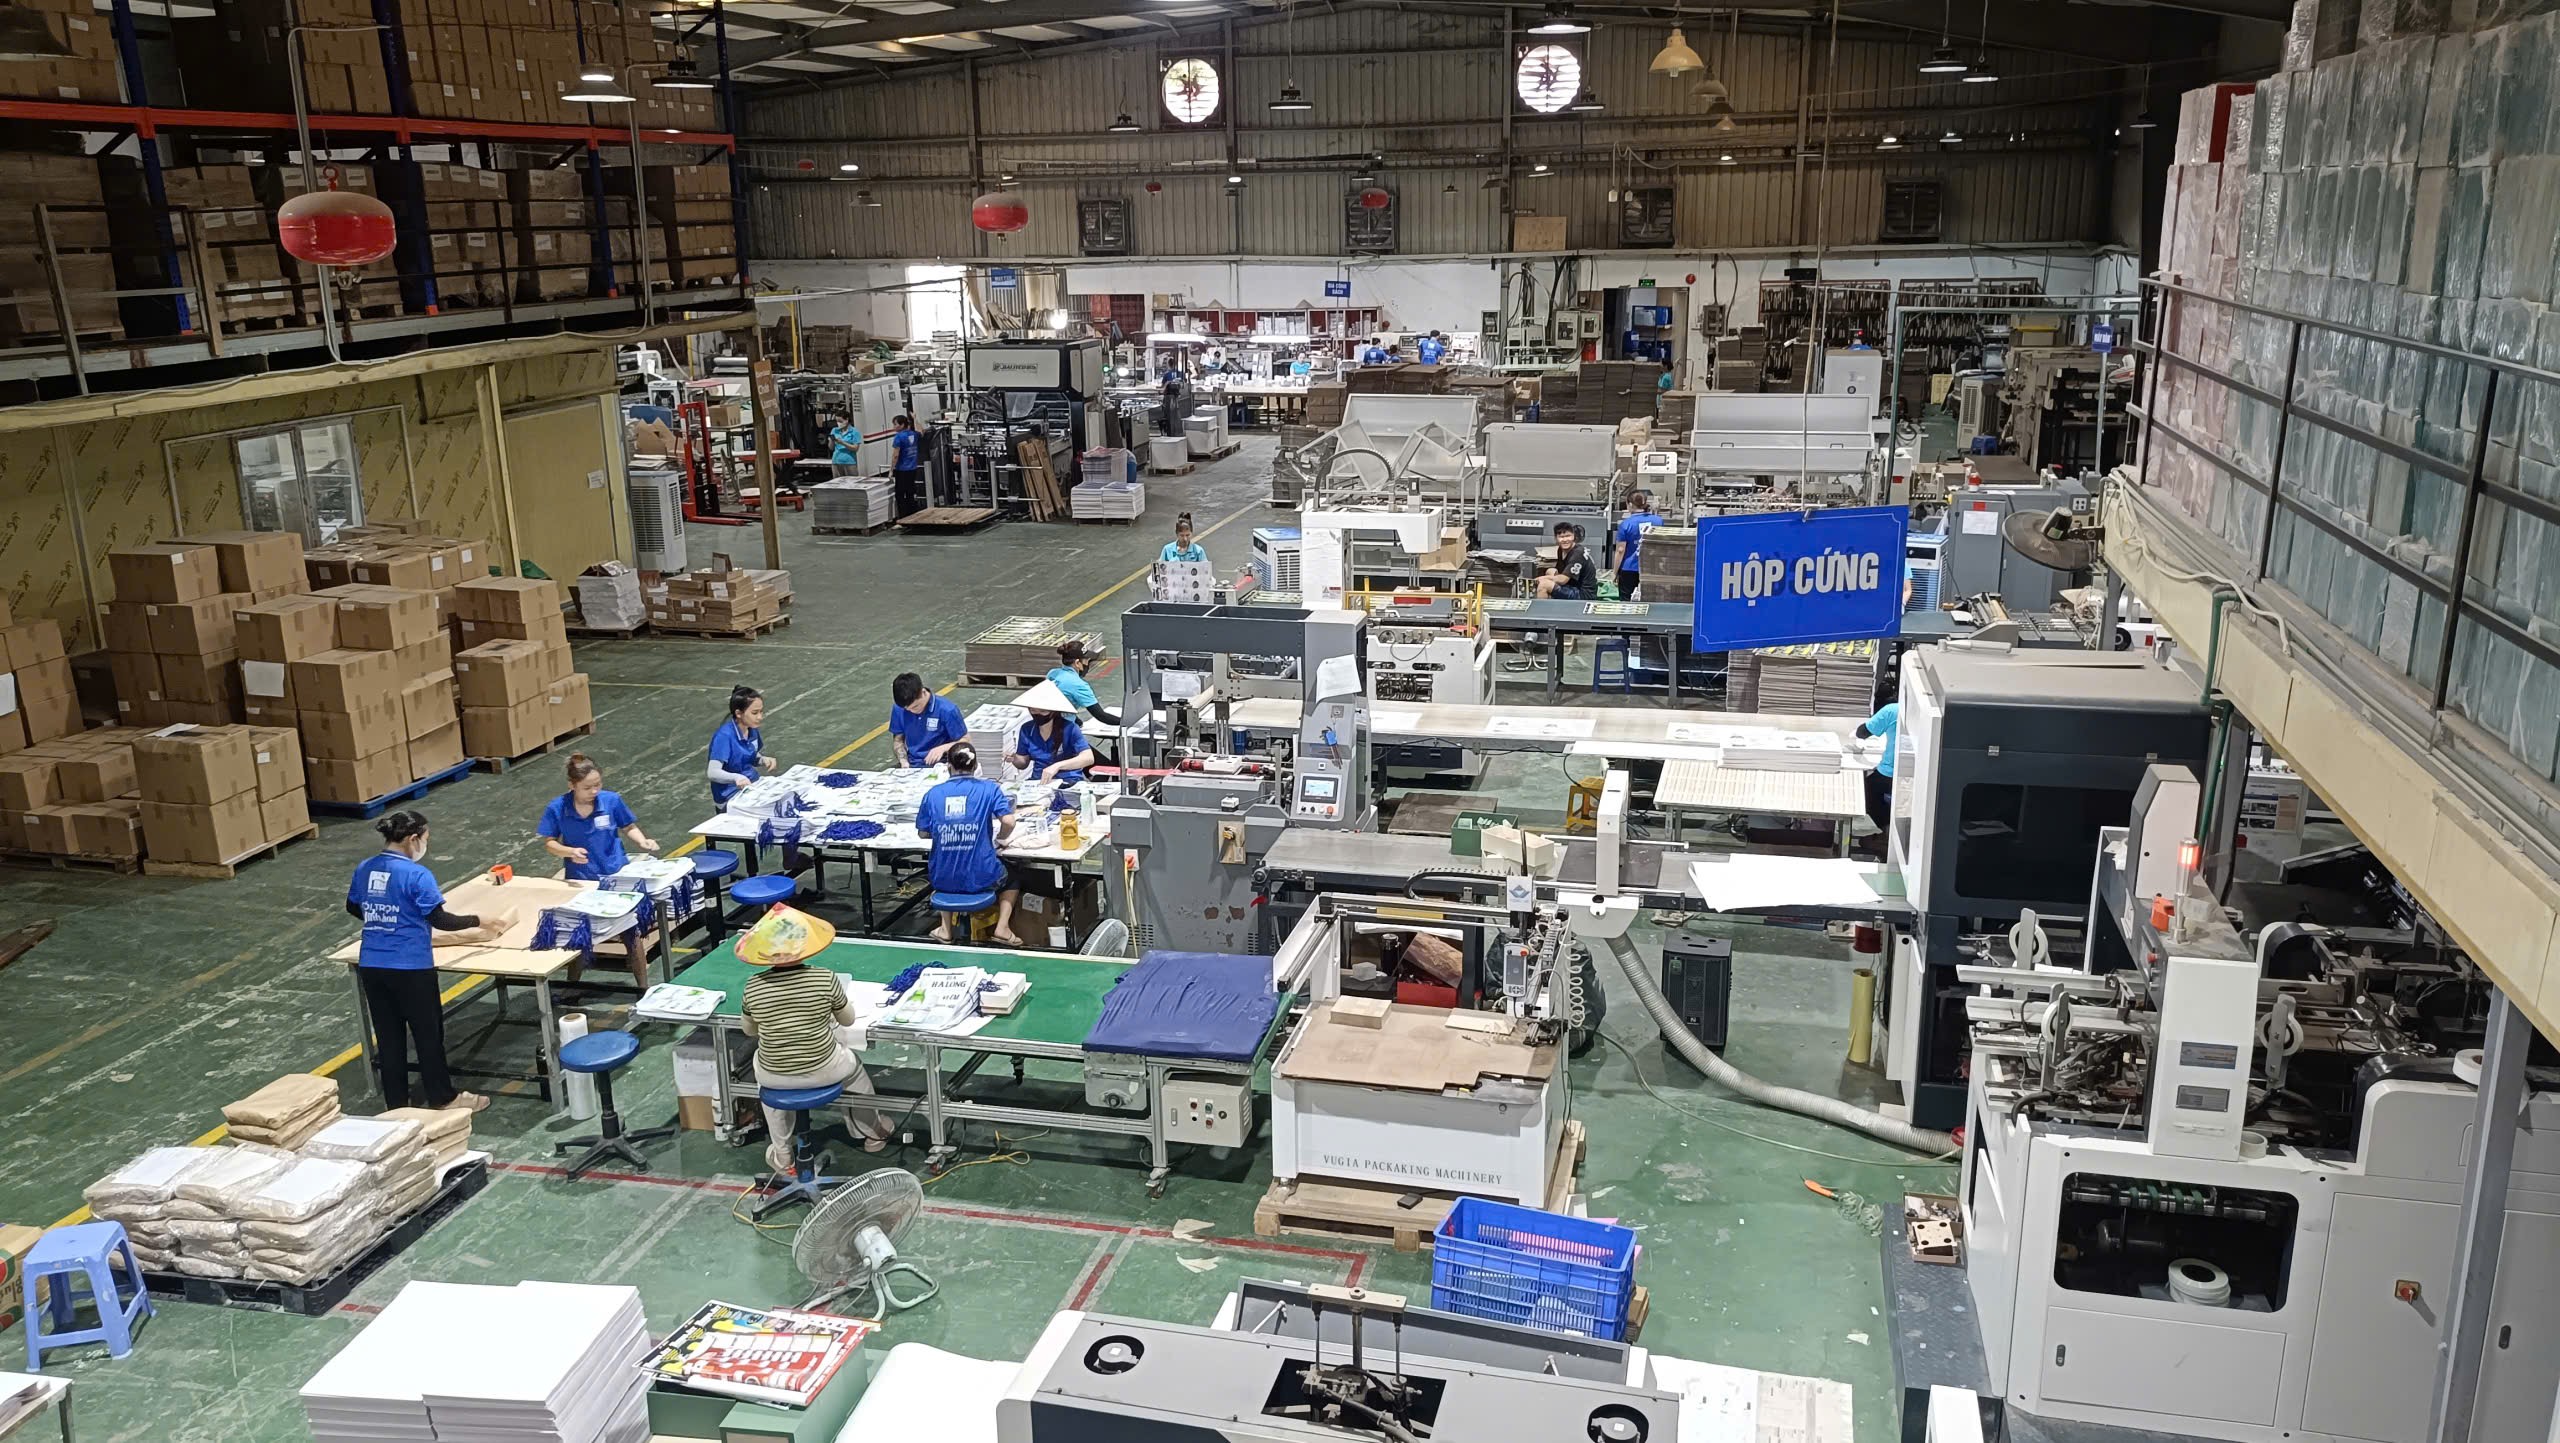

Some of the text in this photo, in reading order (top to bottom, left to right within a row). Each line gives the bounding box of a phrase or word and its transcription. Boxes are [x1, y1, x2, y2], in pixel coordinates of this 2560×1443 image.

[1721, 547, 1880, 606] HỘP CỨNG
[1323, 1154, 1502, 1185] VUGIA PACKAKING MACHINERY
